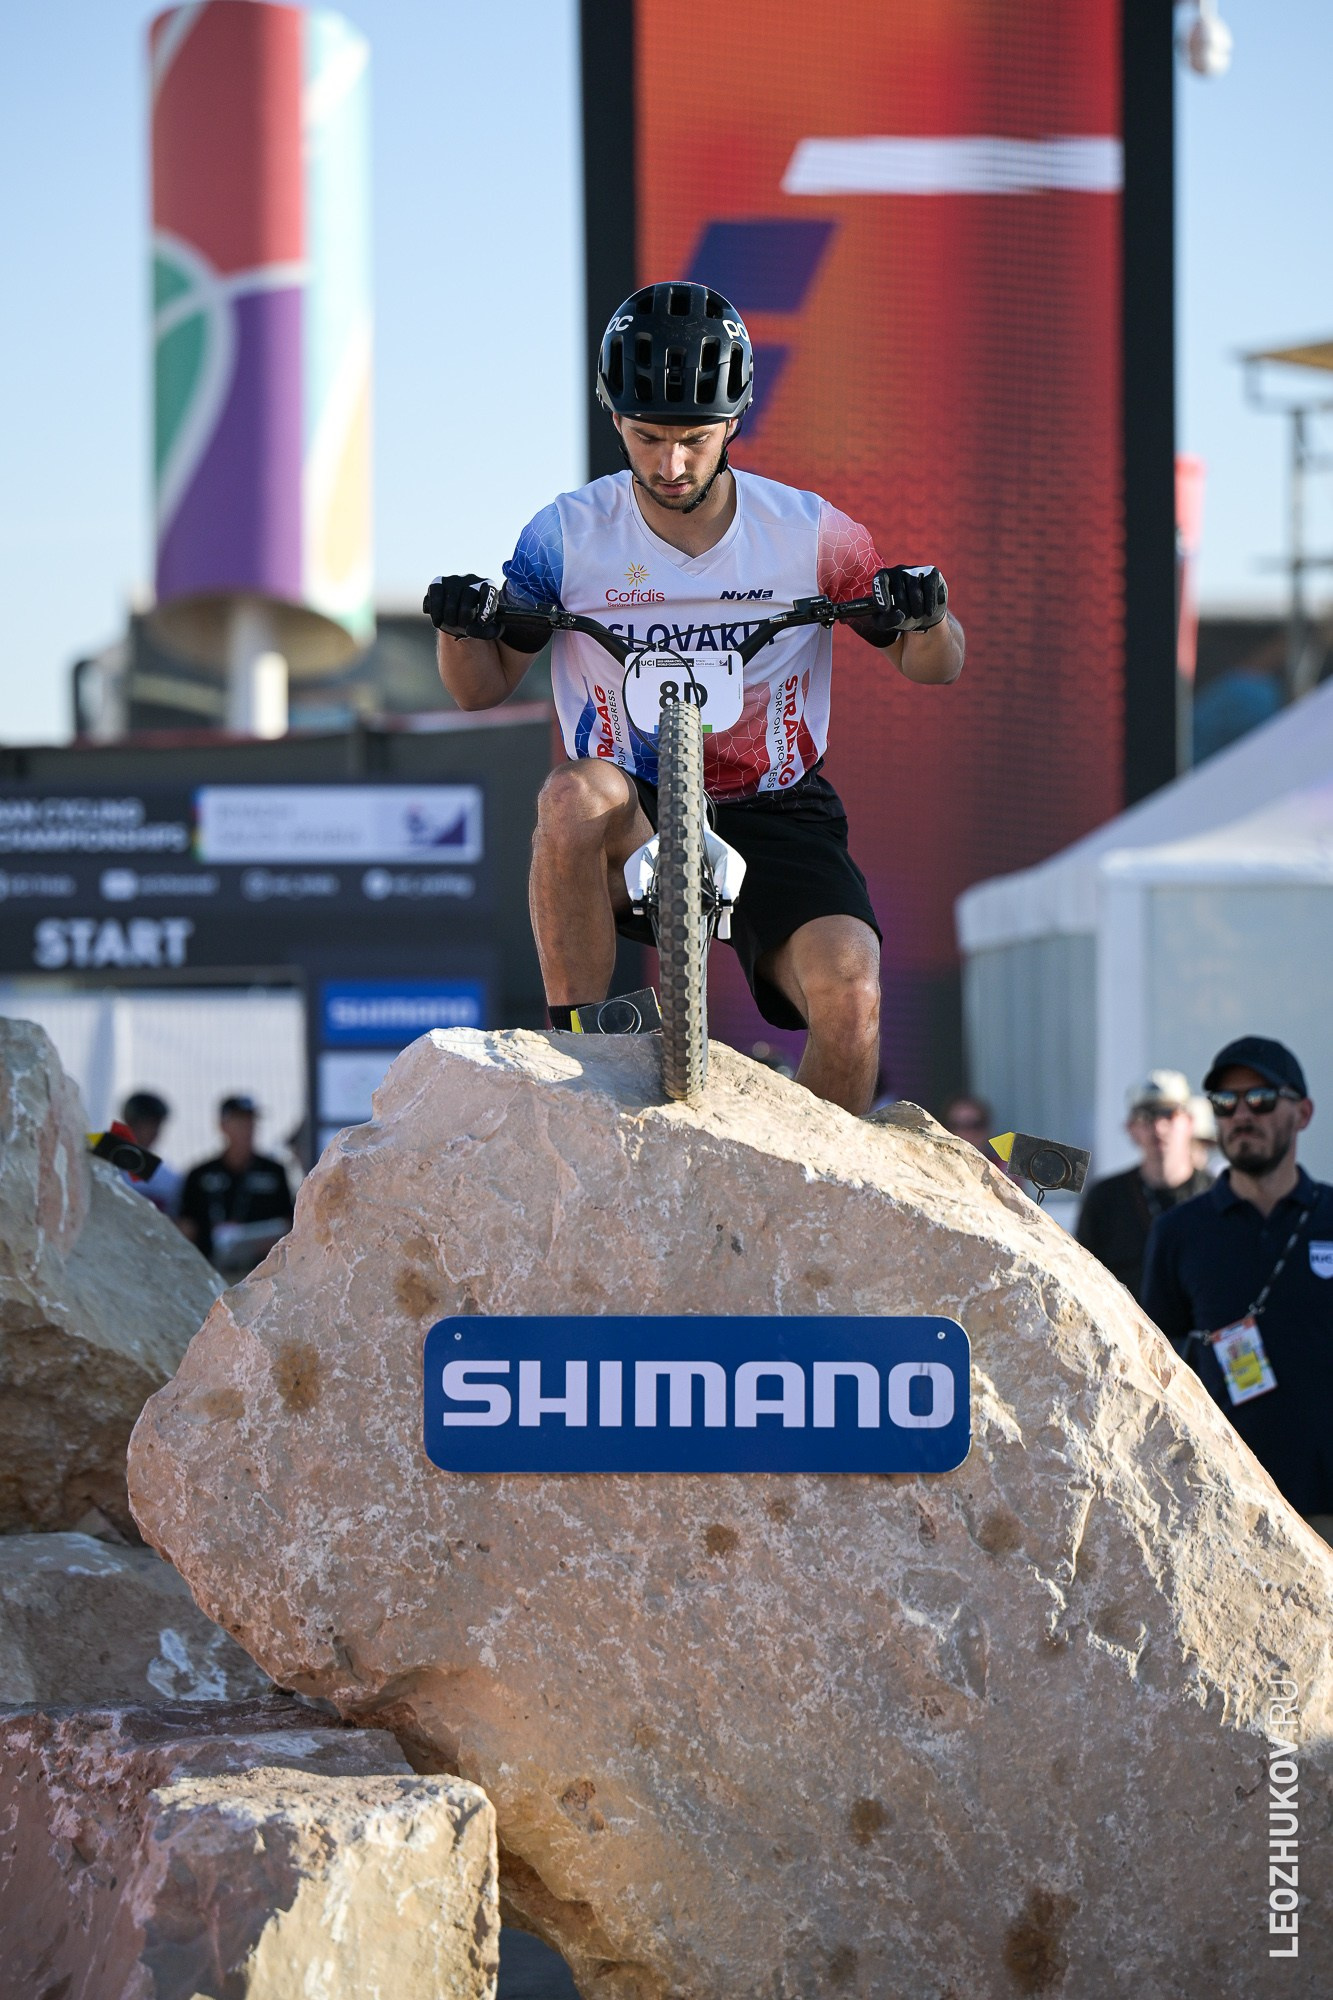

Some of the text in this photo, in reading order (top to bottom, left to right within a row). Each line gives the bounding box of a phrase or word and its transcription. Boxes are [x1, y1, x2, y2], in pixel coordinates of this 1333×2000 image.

[606, 315, 633, 335] OC
[723, 319, 750, 342] PO
[605, 588, 665, 603] Cofidis
[608, 623, 775, 652] SLOVAKI
[640, 659, 655, 667] UCI
[659, 681, 708, 711] 8D
[595, 685, 615, 757] RABAG
[608, 689, 622, 742] PROGRESS
[773, 717, 780, 735] ON
[34, 918, 193, 967] START
[442, 1360, 955, 1428] SHIMANO
